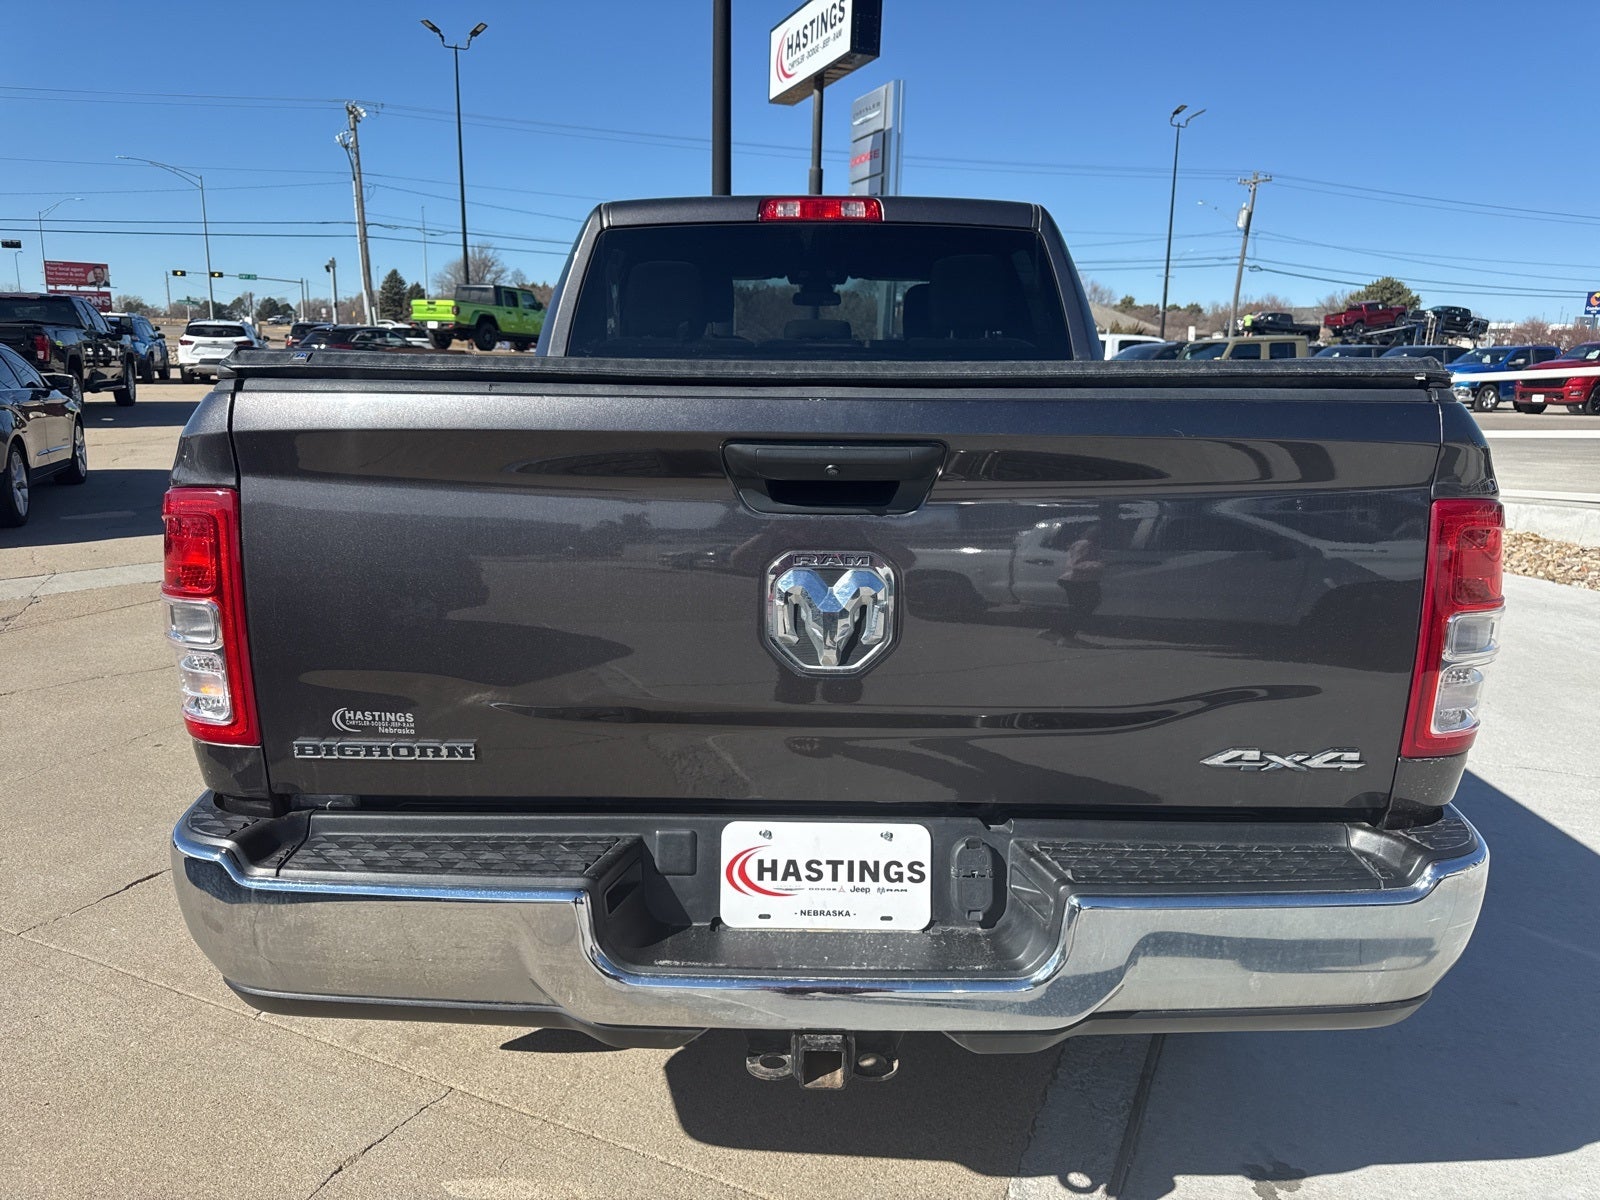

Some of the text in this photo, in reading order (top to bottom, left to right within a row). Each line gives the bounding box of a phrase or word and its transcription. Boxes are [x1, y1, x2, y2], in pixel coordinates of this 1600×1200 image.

[787, 0, 845, 60] HASTINGS
[850, 148, 880, 169] DODGE
[793, 553, 871, 567] RAM
[344, 710, 415, 723] HASTINGS
[378, 726, 415, 735] Nebraska
[293, 738, 477, 761] BIGHORN
[756, 858, 926, 884] HASTINGS
[849, 885, 871, 893] Jeep
[799, 909, 851, 917] NEBRASKA
